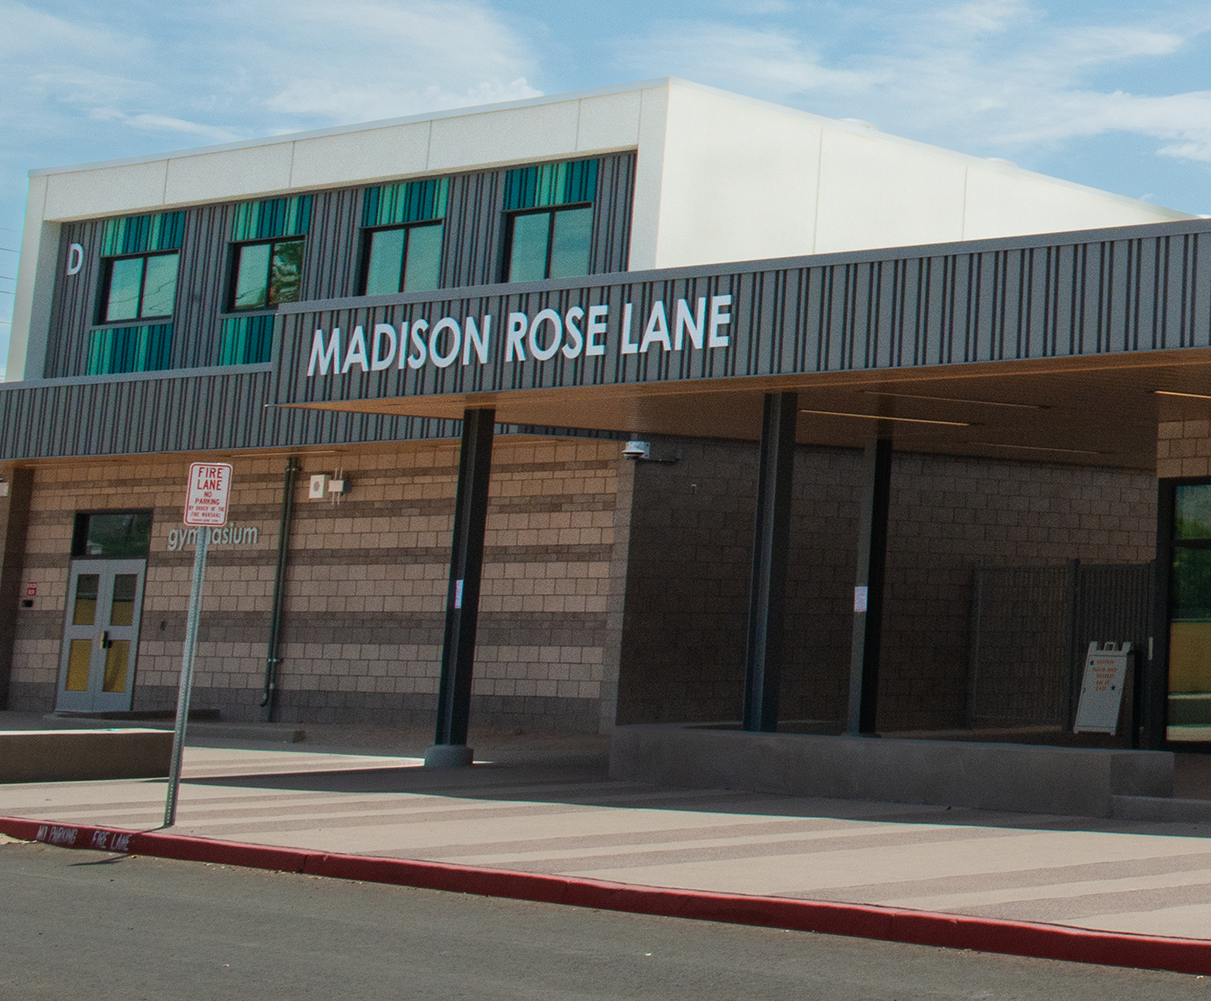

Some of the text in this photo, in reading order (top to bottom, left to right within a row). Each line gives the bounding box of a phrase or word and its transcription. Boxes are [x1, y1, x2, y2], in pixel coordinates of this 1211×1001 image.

[66, 243, 84, 275] D
[307, 294, 732, 376] MADISON ROSE LANE
[198, 467, 223, 478] FIRE
[197, 479, 222, 490] LANE
[91, 830, 110, 849] FIRE
